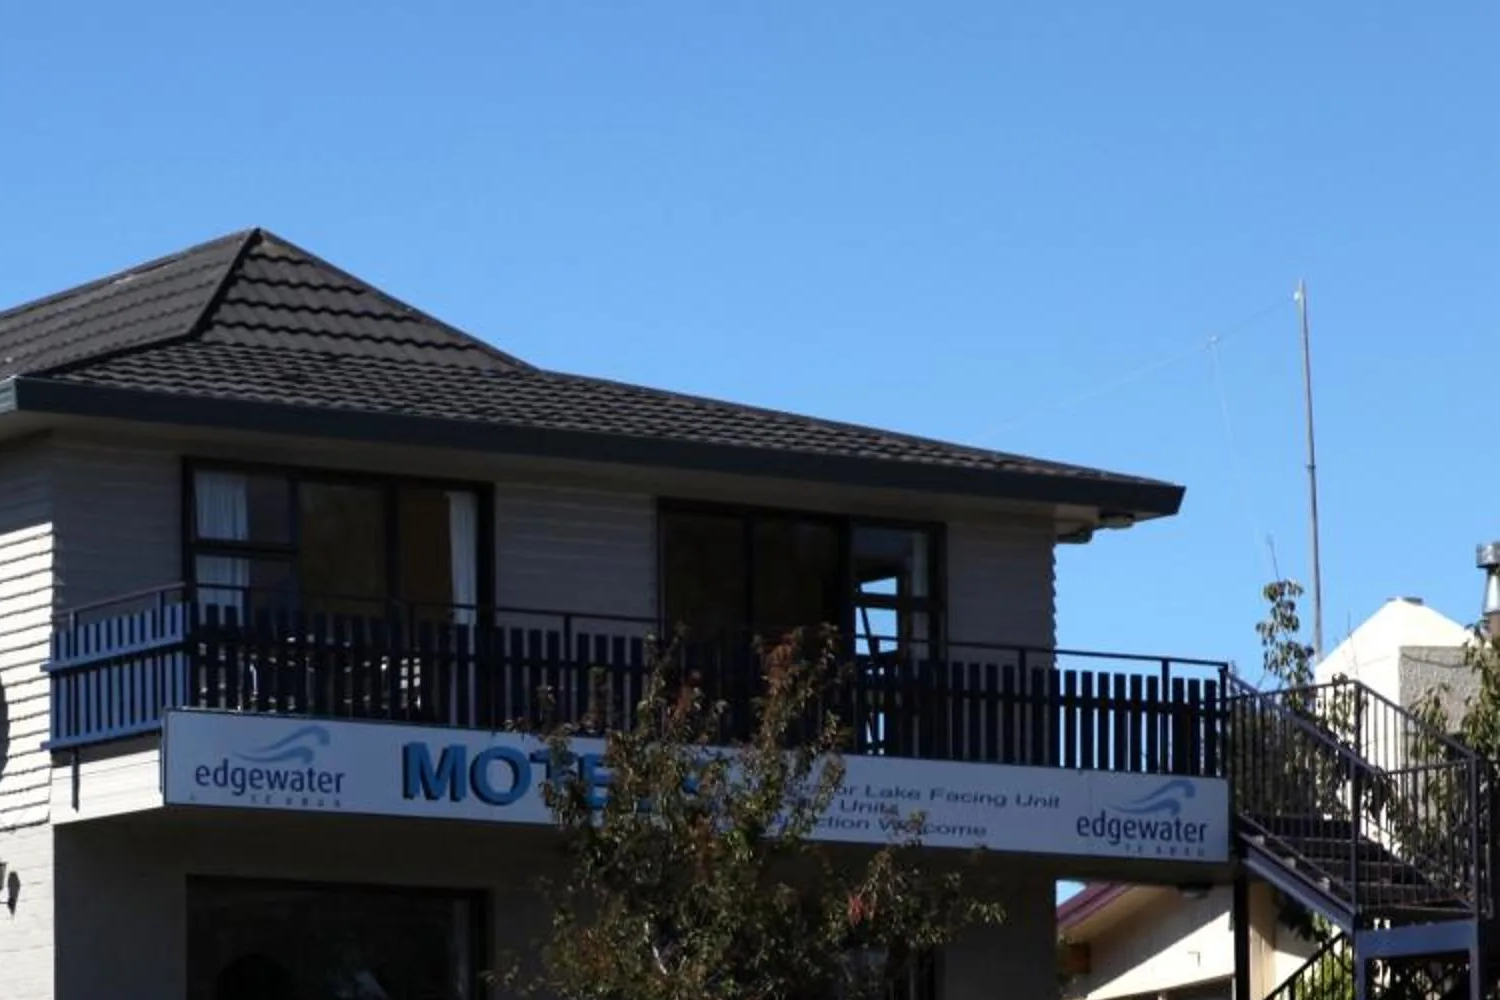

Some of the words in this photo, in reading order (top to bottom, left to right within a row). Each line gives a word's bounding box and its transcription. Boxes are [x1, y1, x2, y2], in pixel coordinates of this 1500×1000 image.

[195, 758, 346, 797] edgewater
[864, 783, 921, 802] Lake
[929, 787, 1008, 808] Facing
[1014, 791, 1061, 810] Unit
[1076, 809, 1208, 845] edgewater
